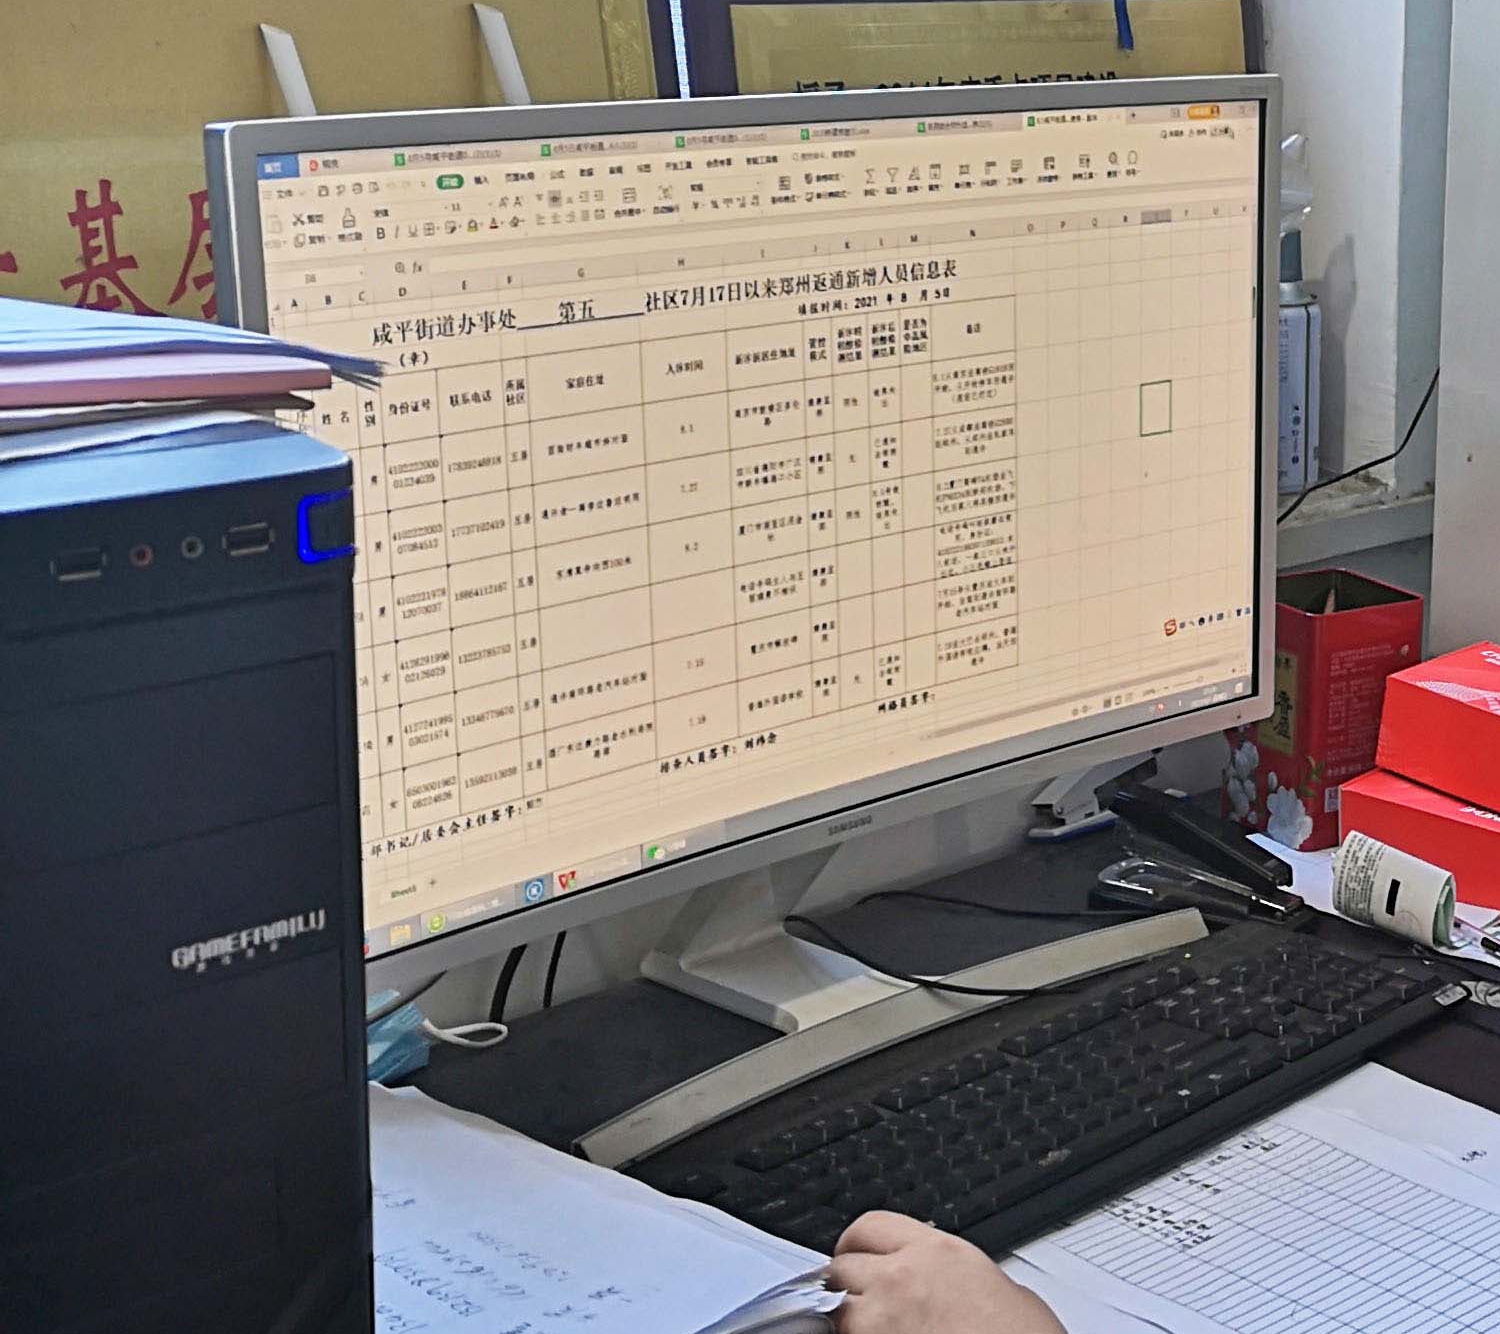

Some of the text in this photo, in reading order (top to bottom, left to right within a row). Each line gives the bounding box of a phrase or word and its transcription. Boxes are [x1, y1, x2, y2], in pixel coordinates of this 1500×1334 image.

[371, 308, 517, 347] 咸平街道办事处
[557, 298, 596, 324] 第五
